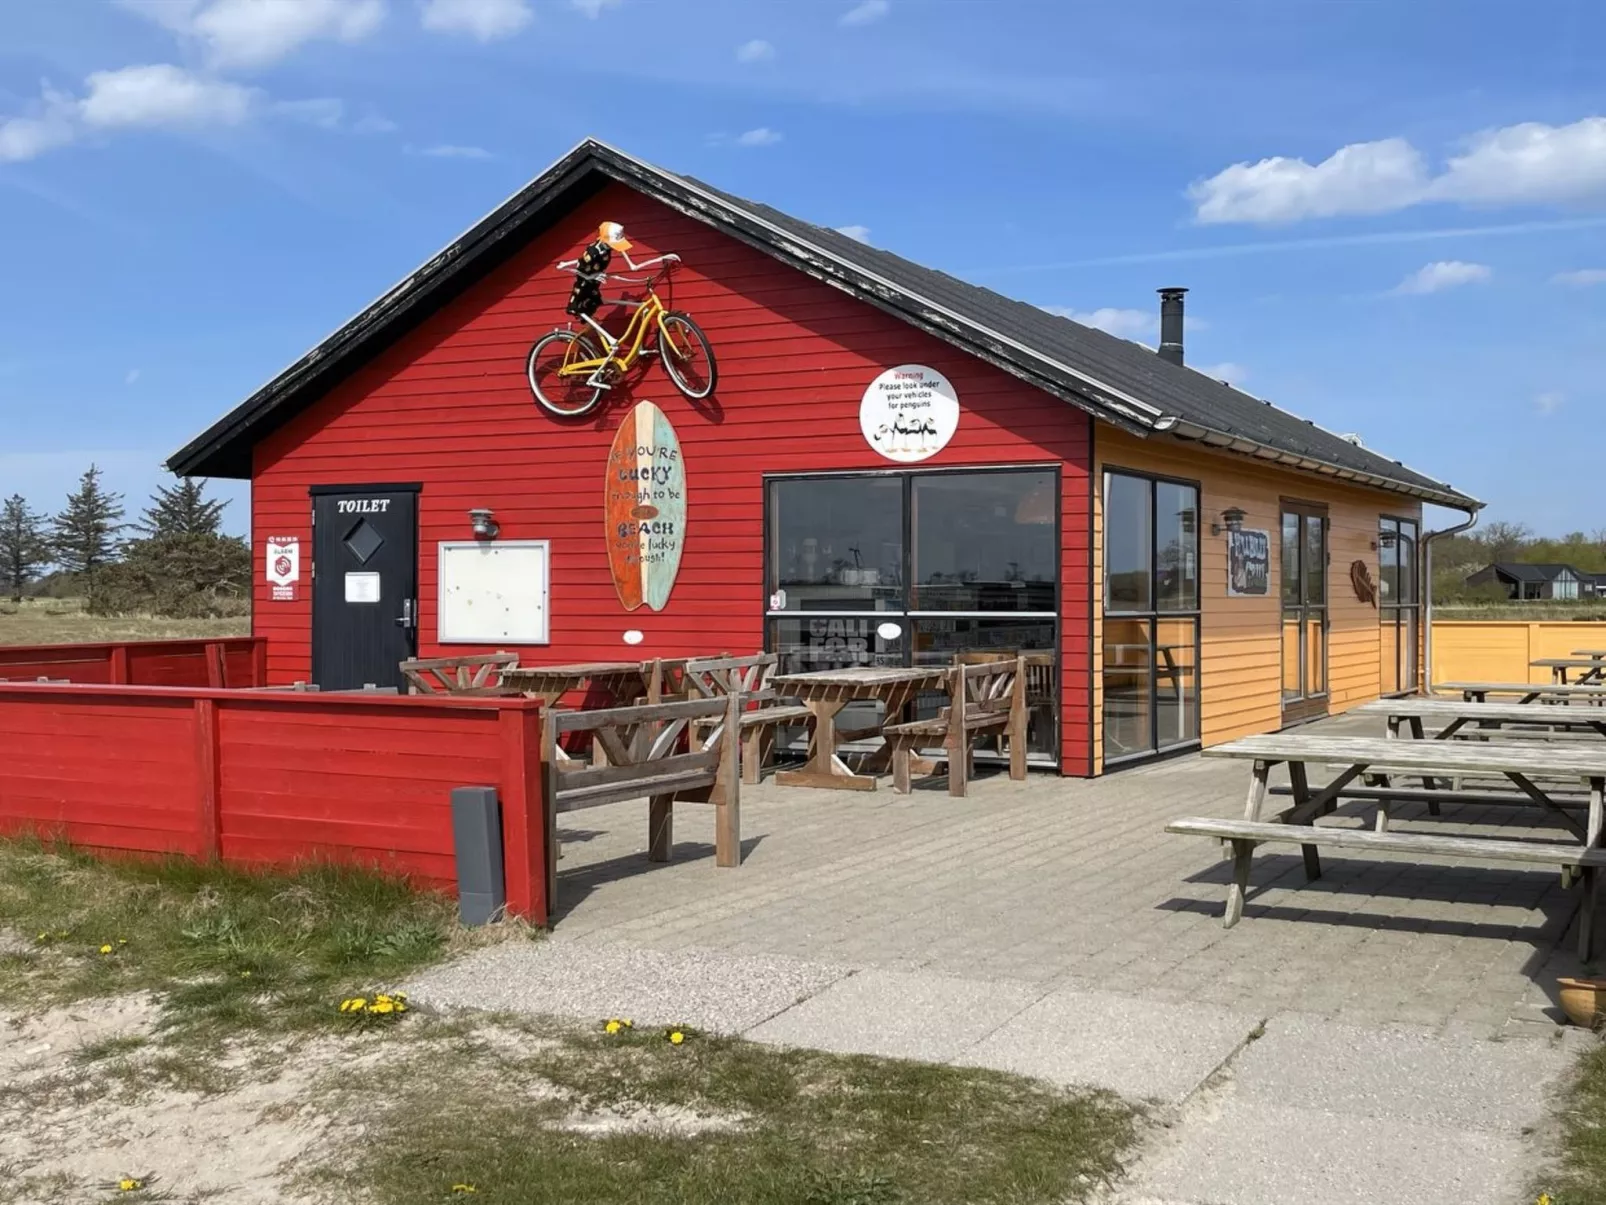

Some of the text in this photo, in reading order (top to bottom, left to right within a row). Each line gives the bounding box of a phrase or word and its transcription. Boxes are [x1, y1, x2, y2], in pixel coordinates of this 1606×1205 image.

[894, 372, 924, 380] Warning
[879, 382, 901, 390] Please
[920, 380, 940, 388] under
[904, 391, 932, 399] vehicles
[900, 401, 931, 410] penguins
[653, 490, 665, 499] to
[667, 487, 680, 499] be
[337, 499, 390, 513] TOILET
[618, 522, 674, 537] BEACH
[648, 538, 676, 551] lucky
[626, 551, 665, 563] ough!
[809, 619, 868, 637] CALI
